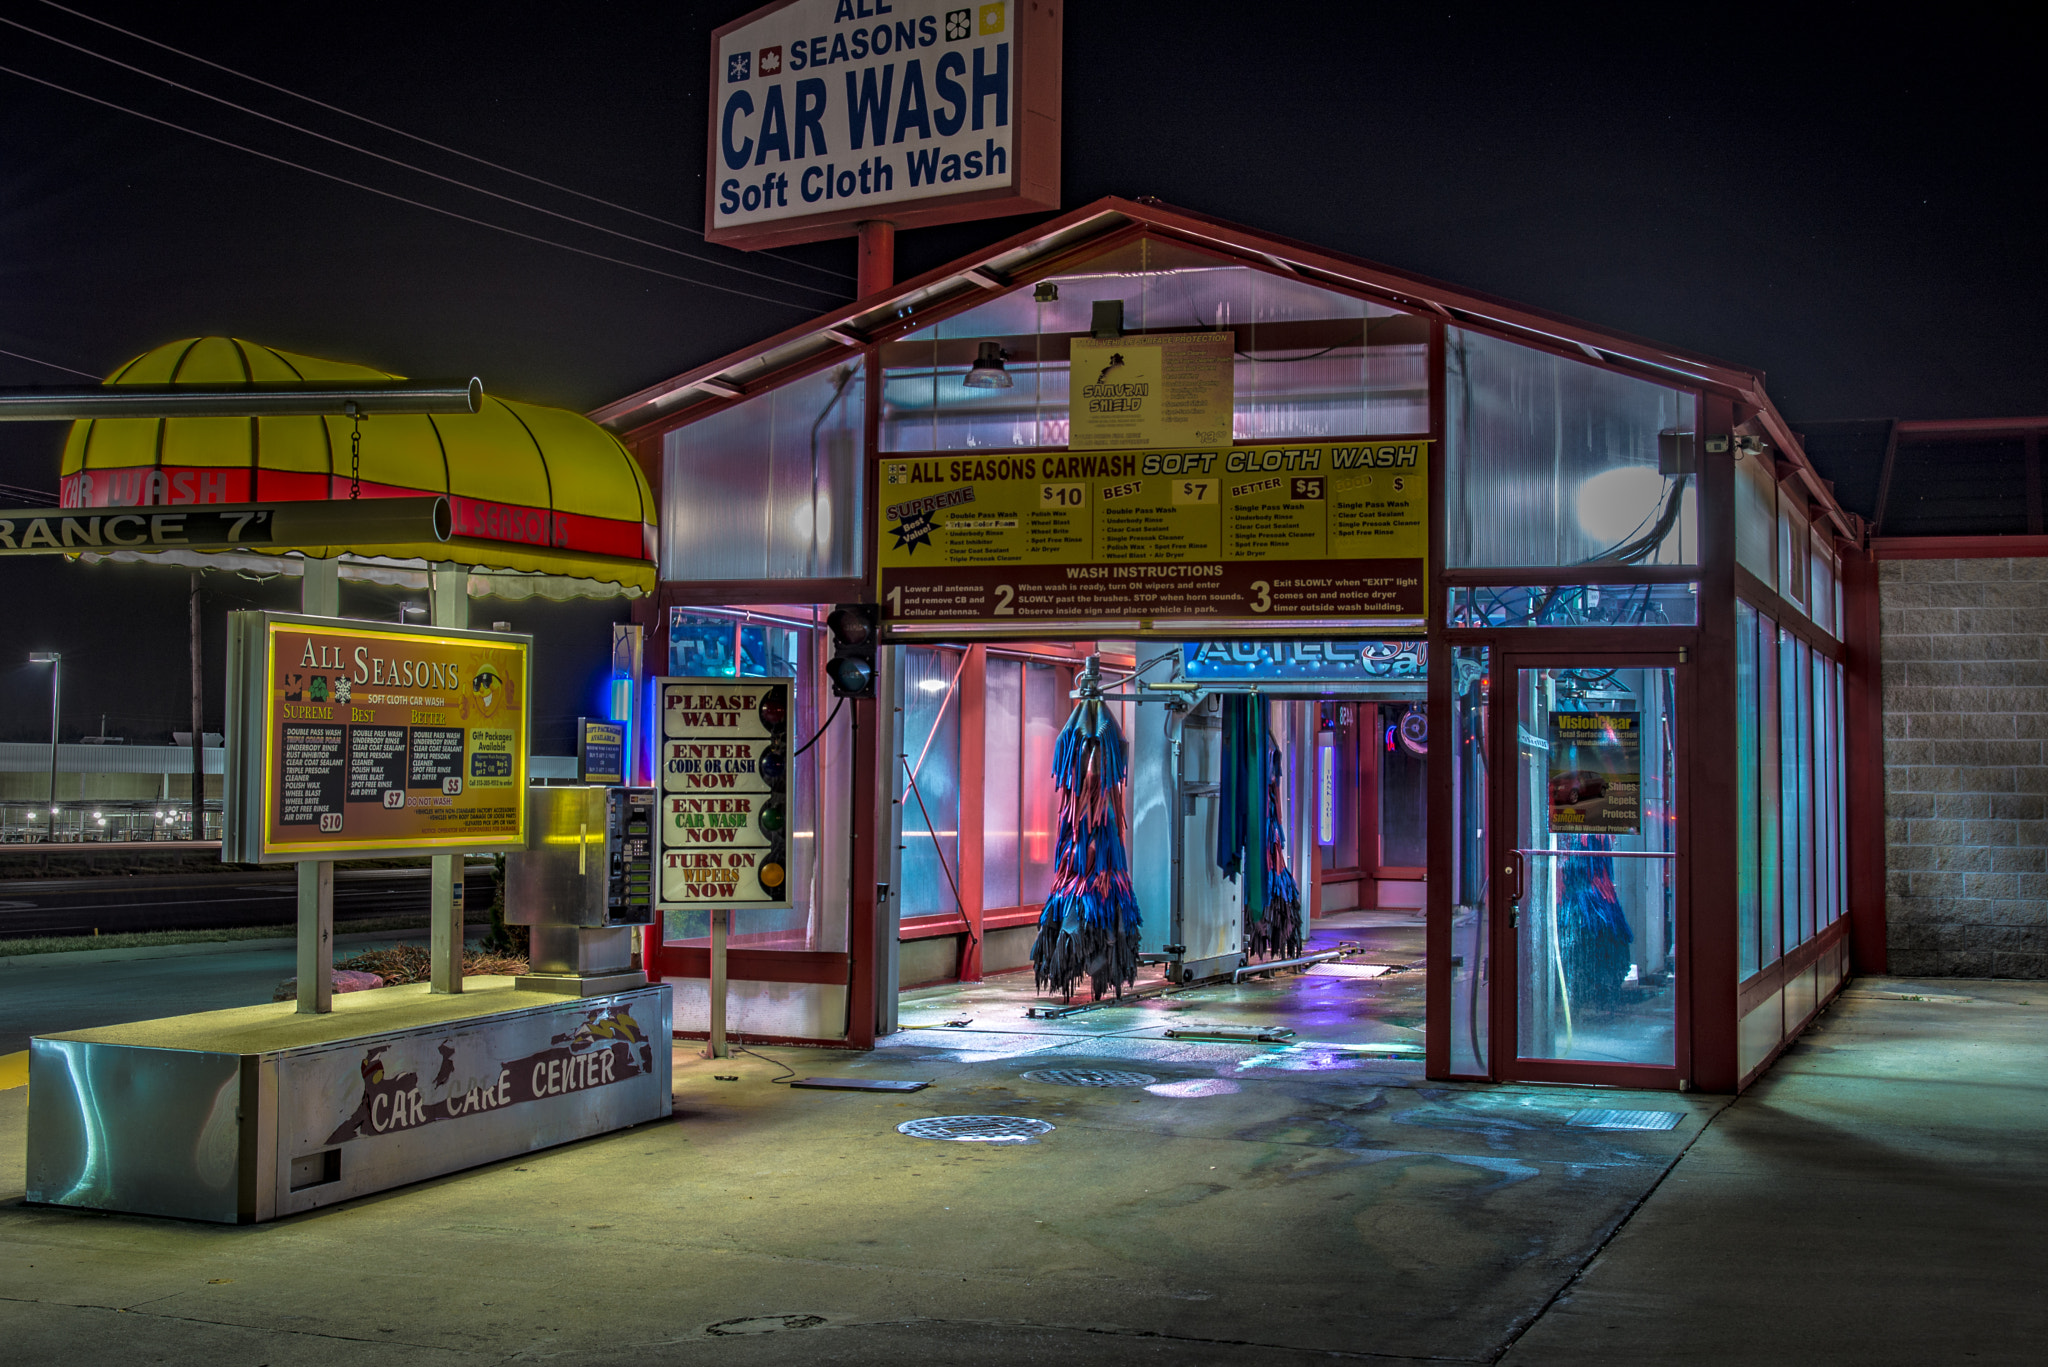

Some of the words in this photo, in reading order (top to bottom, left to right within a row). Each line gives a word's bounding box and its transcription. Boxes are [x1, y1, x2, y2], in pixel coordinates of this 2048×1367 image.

[834, 0, 892, 23] ALL
[789, 15, 937, 71] SEASONS
[722, 77, 828, 170] CAR
[846, 43, 1009, 150] WASH
[719, 172, 788, 215] Soft
[801, 156, 893, 202] Cloth
[906, 139, 1006, 187] Wash
[1175, 334, 1227, 343] PROTECTION
[1083, 383, 1148, 398] SAMURAI
[1090, 398, 1142, 412] SHIELD
[910, 462, 944, 483] ALL
[950, 458, 1036, 482] SEASONS
[1042, 455, 1135, 478] CARWASH
[1142, 452, 1218, 475] SOFT
[1226, 449, 1322, 472] CLOTH
[1332, 446, 1418, 469] WASH
[64, 474, 93, 508] CAR
[108, 471, 227, 507] WASH
[1104, 481, 1142, 500] BEST
[1184, 483, 1208, 500] $7
[1232, 478, 1281, 496] BETTER
[1296, 480, 1320, 498] $5
[1044, 487, 1082, 505] $10
[887, 486, 975, 521] SUPREME
[473, 503, 568, 546] SEASONS
[902, 516, 924, 532] Best
[903, 523, 932, 542] Value!
[1066, 568, 1108, 579] WASH
[1114, 565, 1223, 578] INSTRUCTIONS
[1079, 583, 1106, 592] ready,
[1129, 582, 1142, 590] ON
[1145, 582, 1175, 591] wipers
[1362, 578, 1394, 586] "EXIT"
[1396, 578, 1418, 586] light
[886, 586, 901, 616] 1
[955, 596, 966, 604] CB
[993, 584, 1014, 615] 2
[1056, 596, 1075, 604] past
[1134, 594, 1157, 602] STOP
[1250, 580, 1272, 613] 3
[1372, 591, 1396, 600] dryer
[1084, 607, 1102, 616] sign
[1123, 607, 1147, 615] place
[1195, 606, 1218, 614] park.
[1274, 604, 1298, 612] timer
[1364, 603, 1404, 612] building.
[300, 637, 346, 670] ALL
[354, 646, 459, 690] SEASONS
[368, 694, 386, 704] SOFT
[387, 695, 409, 705] CLOTH
[410, 696, 423, 705] CAR
[424, 696, 444, 706] WASH
[666, 695, 756, 710] PLEASE
[284, 704, 334, 720] SUPREME
[351, 708, 376, 723] BEST
[411, 710, 446, 725] BETTER
[682, 712, 740, 727] WAIT
[1558, 716, 1632, 730] VisionClear
[472, 731, 484, 740] Gift
[485, 732, 512, 743] Packages
[478, 742, 506, 751] Available
[672, 744, 752, 758] ENTER
[668, 759, 701, 773] CODE
[704, 760, 721, 773] OR
[724, 760, 756, 773] CASH
[447, 779, 458, 792] $5
[686, 774, 738, 788] NOW
[388, 792, 400, 806] $7
[408, 797, 417, 806] DO
[420, 796, 431, 806] NOT
[672, 799, 751, 813] ENTER
[1608, 796, 1638, 805] Repels.
[1553, 814, 1585, 823] SIMONIZ
[1603, 809, 1638, 818] Protects.
[322, 815, 341, 830] $10
[675, 814, 704, 829] CAR
[708, 814, 747, 828] WASH
[685, 829, 738, 842] NOW
[666, 854, 722, 868] TURN
[728, 854, 756, 868] ON
[683, 869, 739, 883] WIPERS
[685, 884, 737, 897] NOW
[372, 1088, 426, 1132] CAR
[532, 1048, 616, 1098] CENTER
